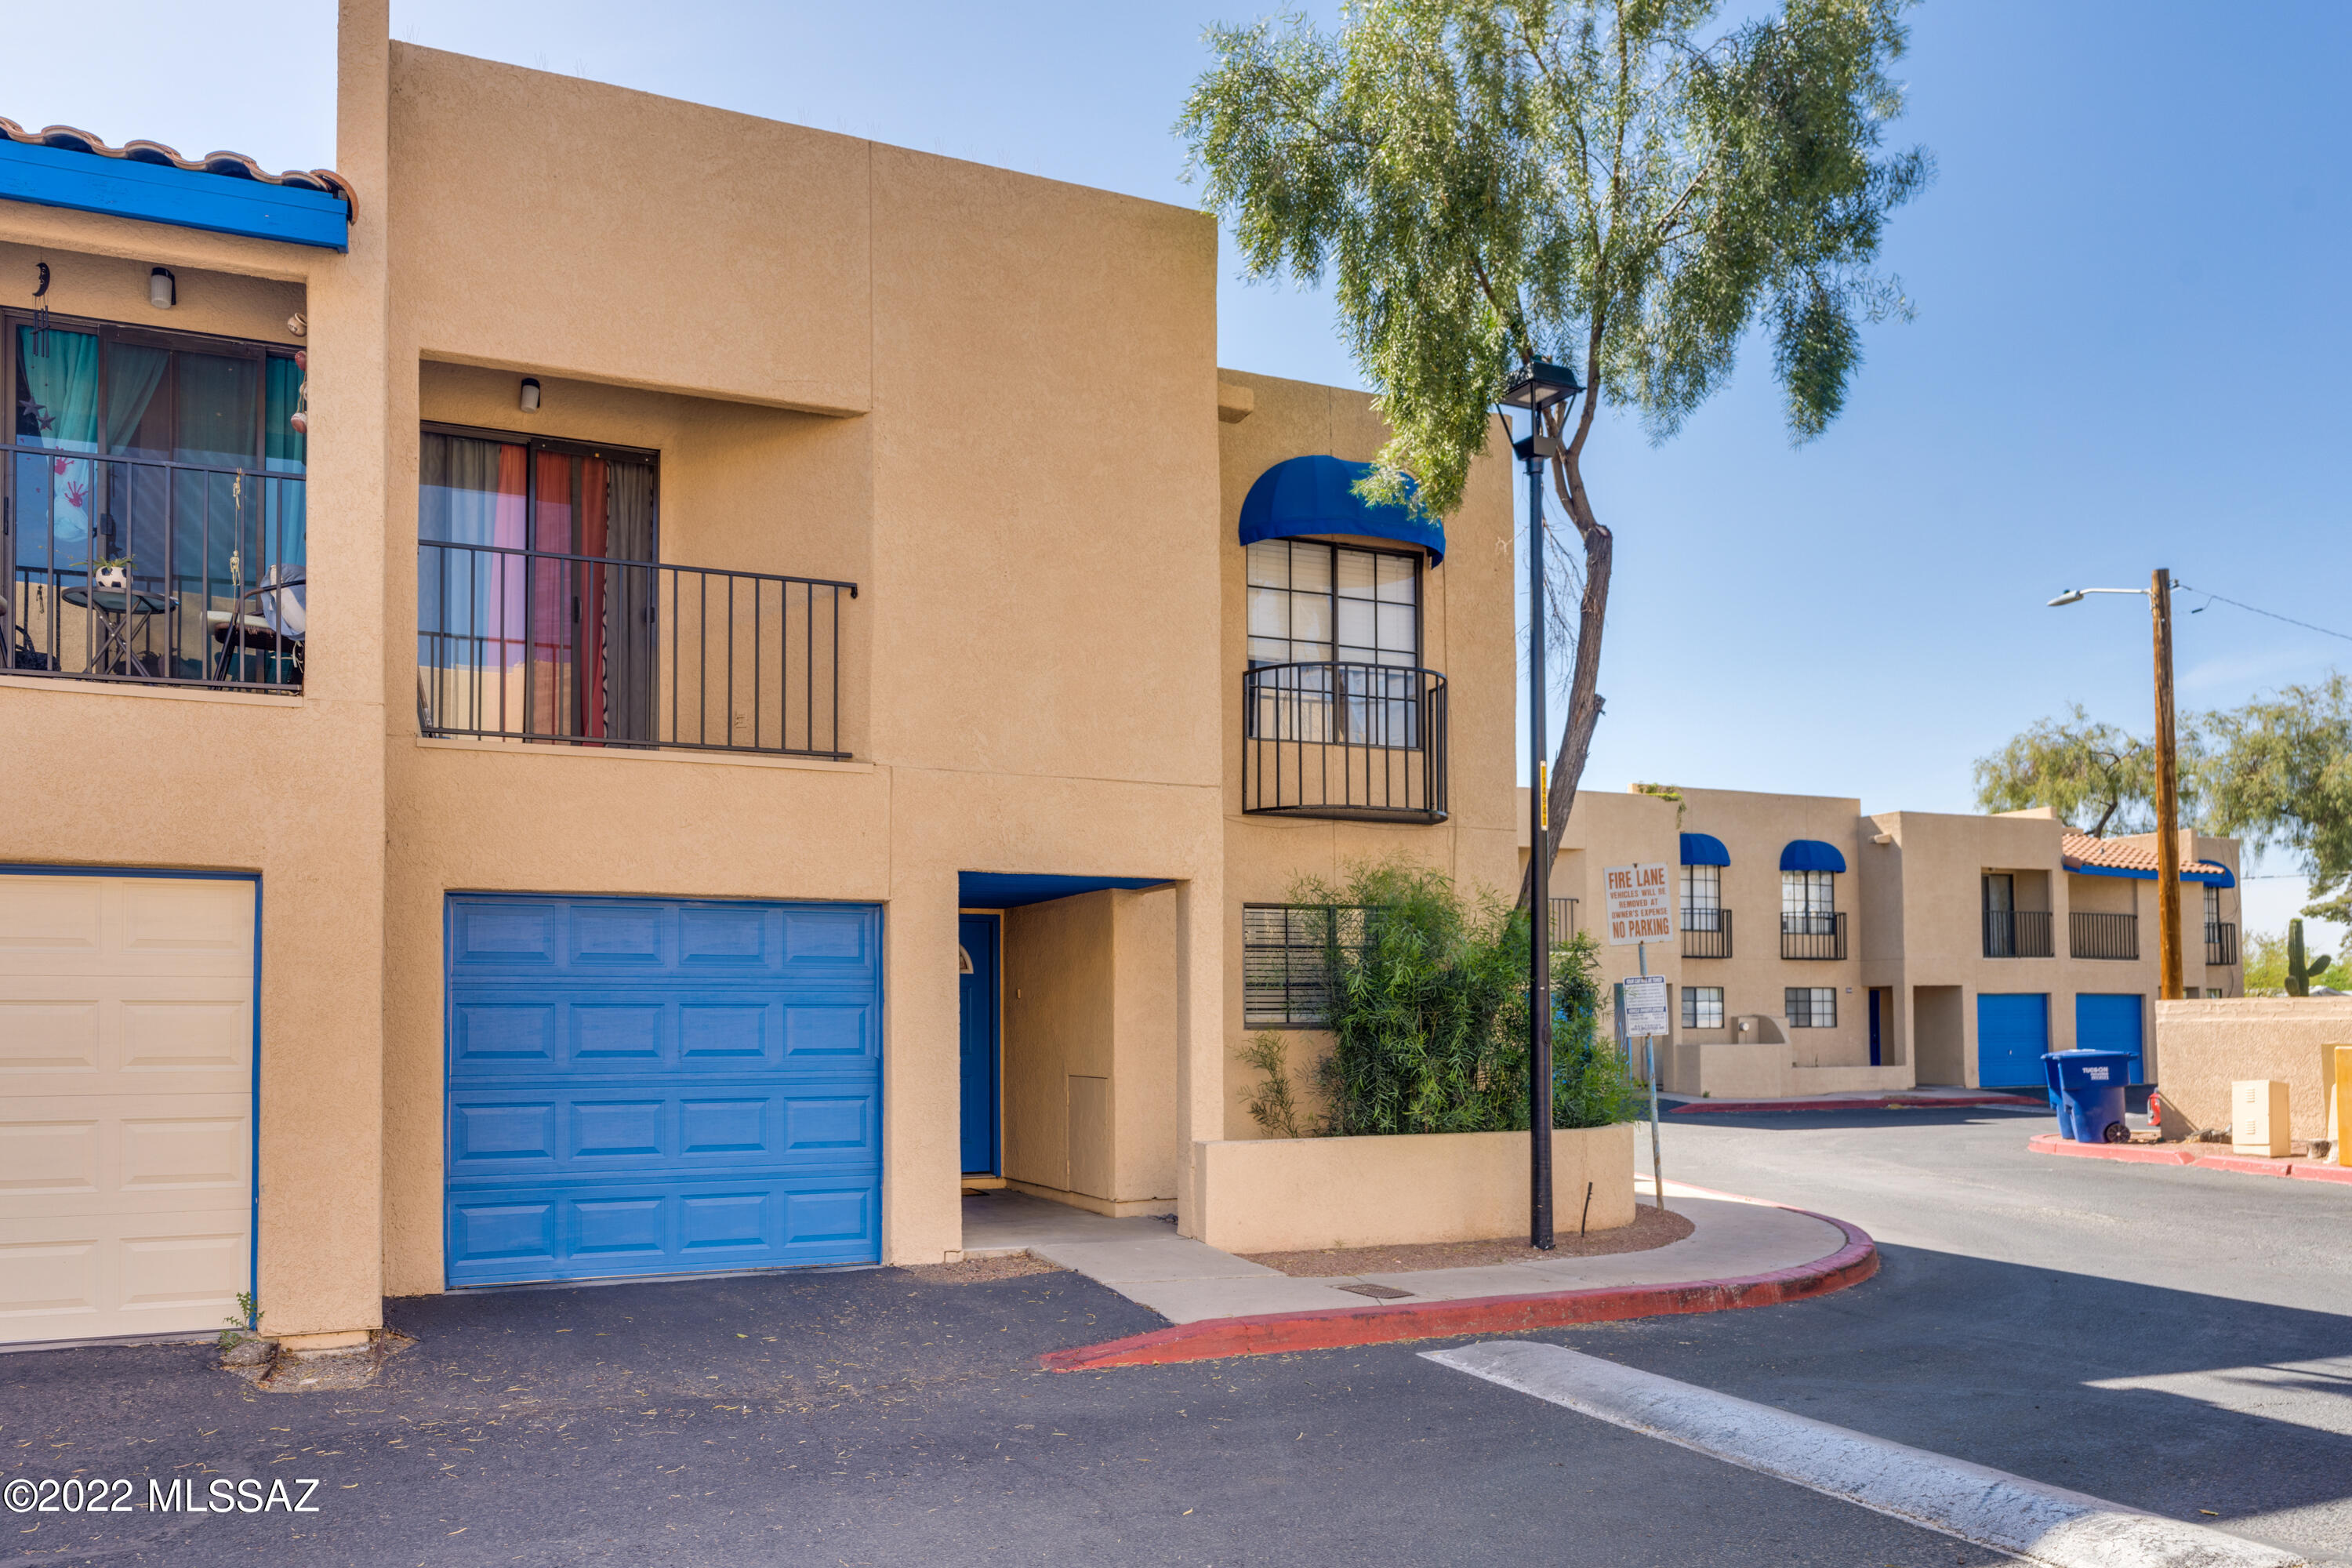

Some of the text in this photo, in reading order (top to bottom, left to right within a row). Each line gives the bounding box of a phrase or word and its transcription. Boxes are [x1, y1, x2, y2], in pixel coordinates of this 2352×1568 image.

[1608, 868, 1665, 889] FIRE LANE
[1610, 890, 1639, 899] VEHICLES
[1641, 888, 1656, 897] WILL
[1618, 899, 1648, 909] REMOVED
[1612, 907, 1668, 919] OWNER'S EXPENSE
[1613, 917, 1669, 939] NO PARKING
